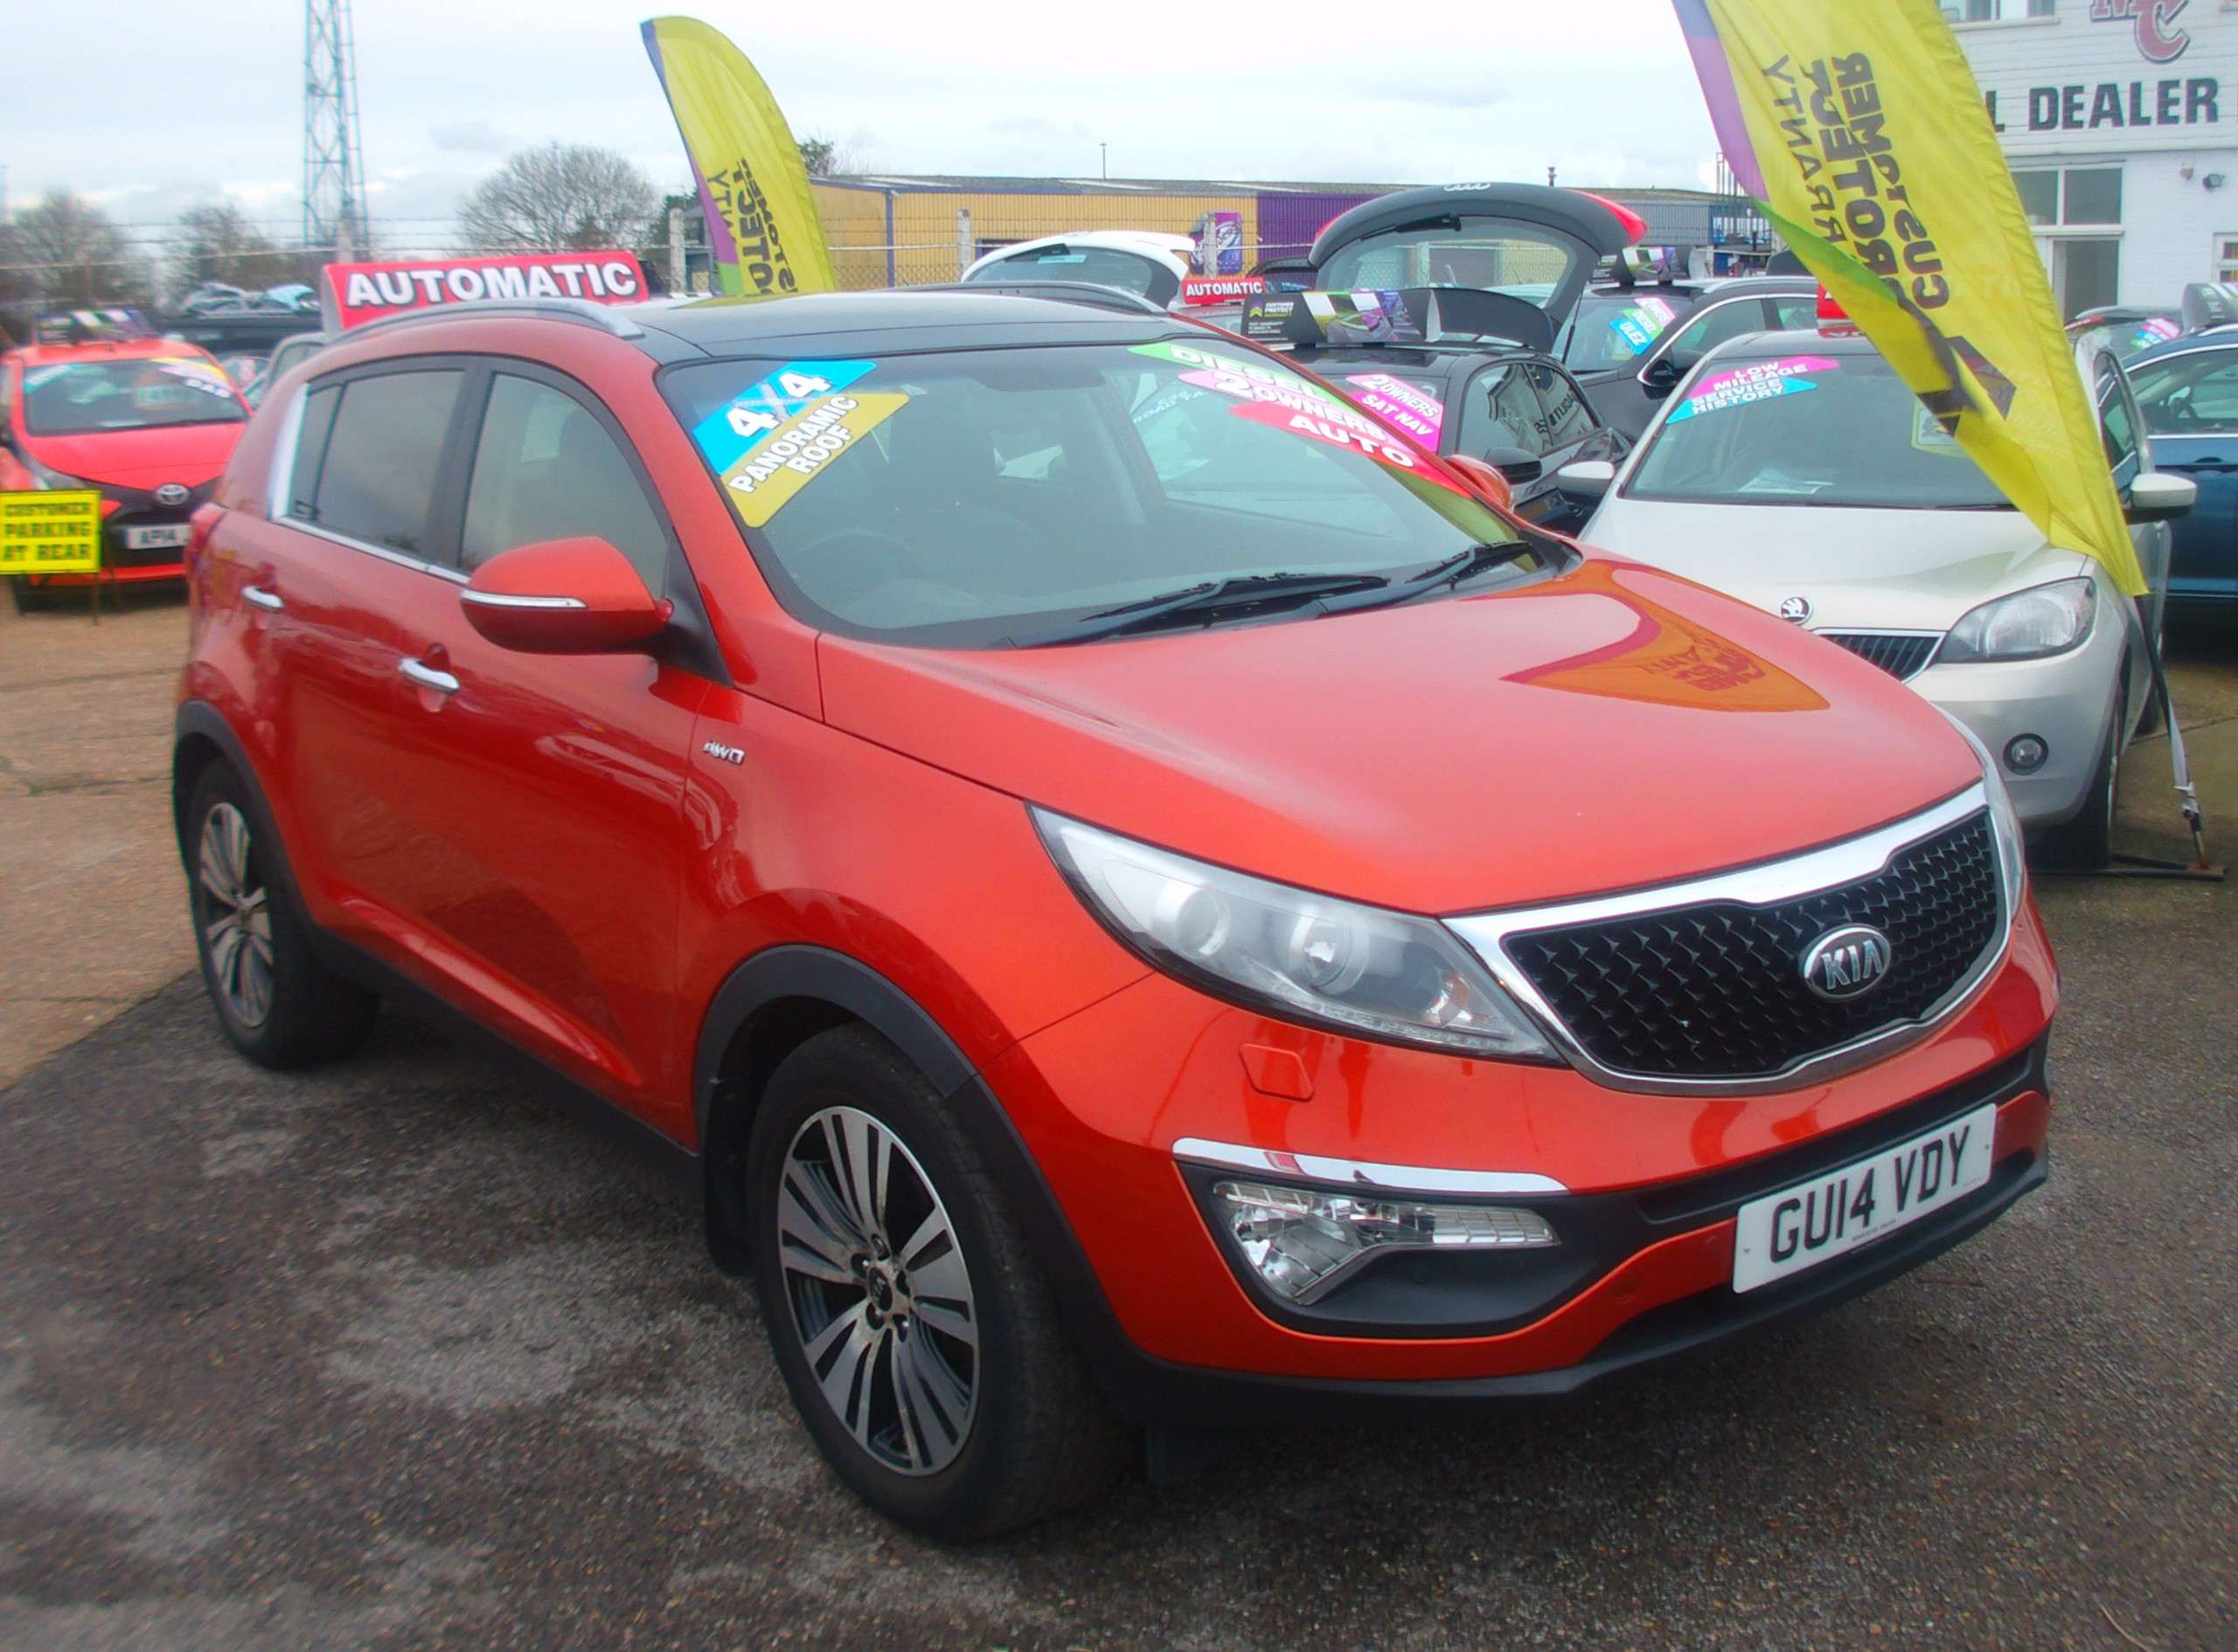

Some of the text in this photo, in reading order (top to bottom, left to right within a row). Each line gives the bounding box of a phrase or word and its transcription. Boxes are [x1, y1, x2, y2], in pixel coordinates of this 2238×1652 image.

[2028, 78, 2219, 132] DEALER
[346, 262, 638, 307] AUTOMATIC
[1185, 281, 1263, 296] AUTOMATIC
[1169, 344, 1331, 404] DIESEL
[1690, 378, 1783, 405] SERVICE
[1713, 364, 1809, 392] MILEAGE
[1734, 361, 1780, 379] LOW
[1361, 393, 1436, 437] SAT NAV
[1692, 385, 1785, 415] HISTORY
[728, 396, 858, 493] PANORAMIC
[786, 424, 853, 475] ROOF
[1289, 414, 1414, 468] AUTO
[3, 503, 91, 517] CUSTOMER
[3, 521, 90, 538] PARKING
[3, 543, 90, 561] AT REAR
[1820, 939, 1883, 991] KIA
[1769, 1123, 1970, 1265] GU14 VDY
